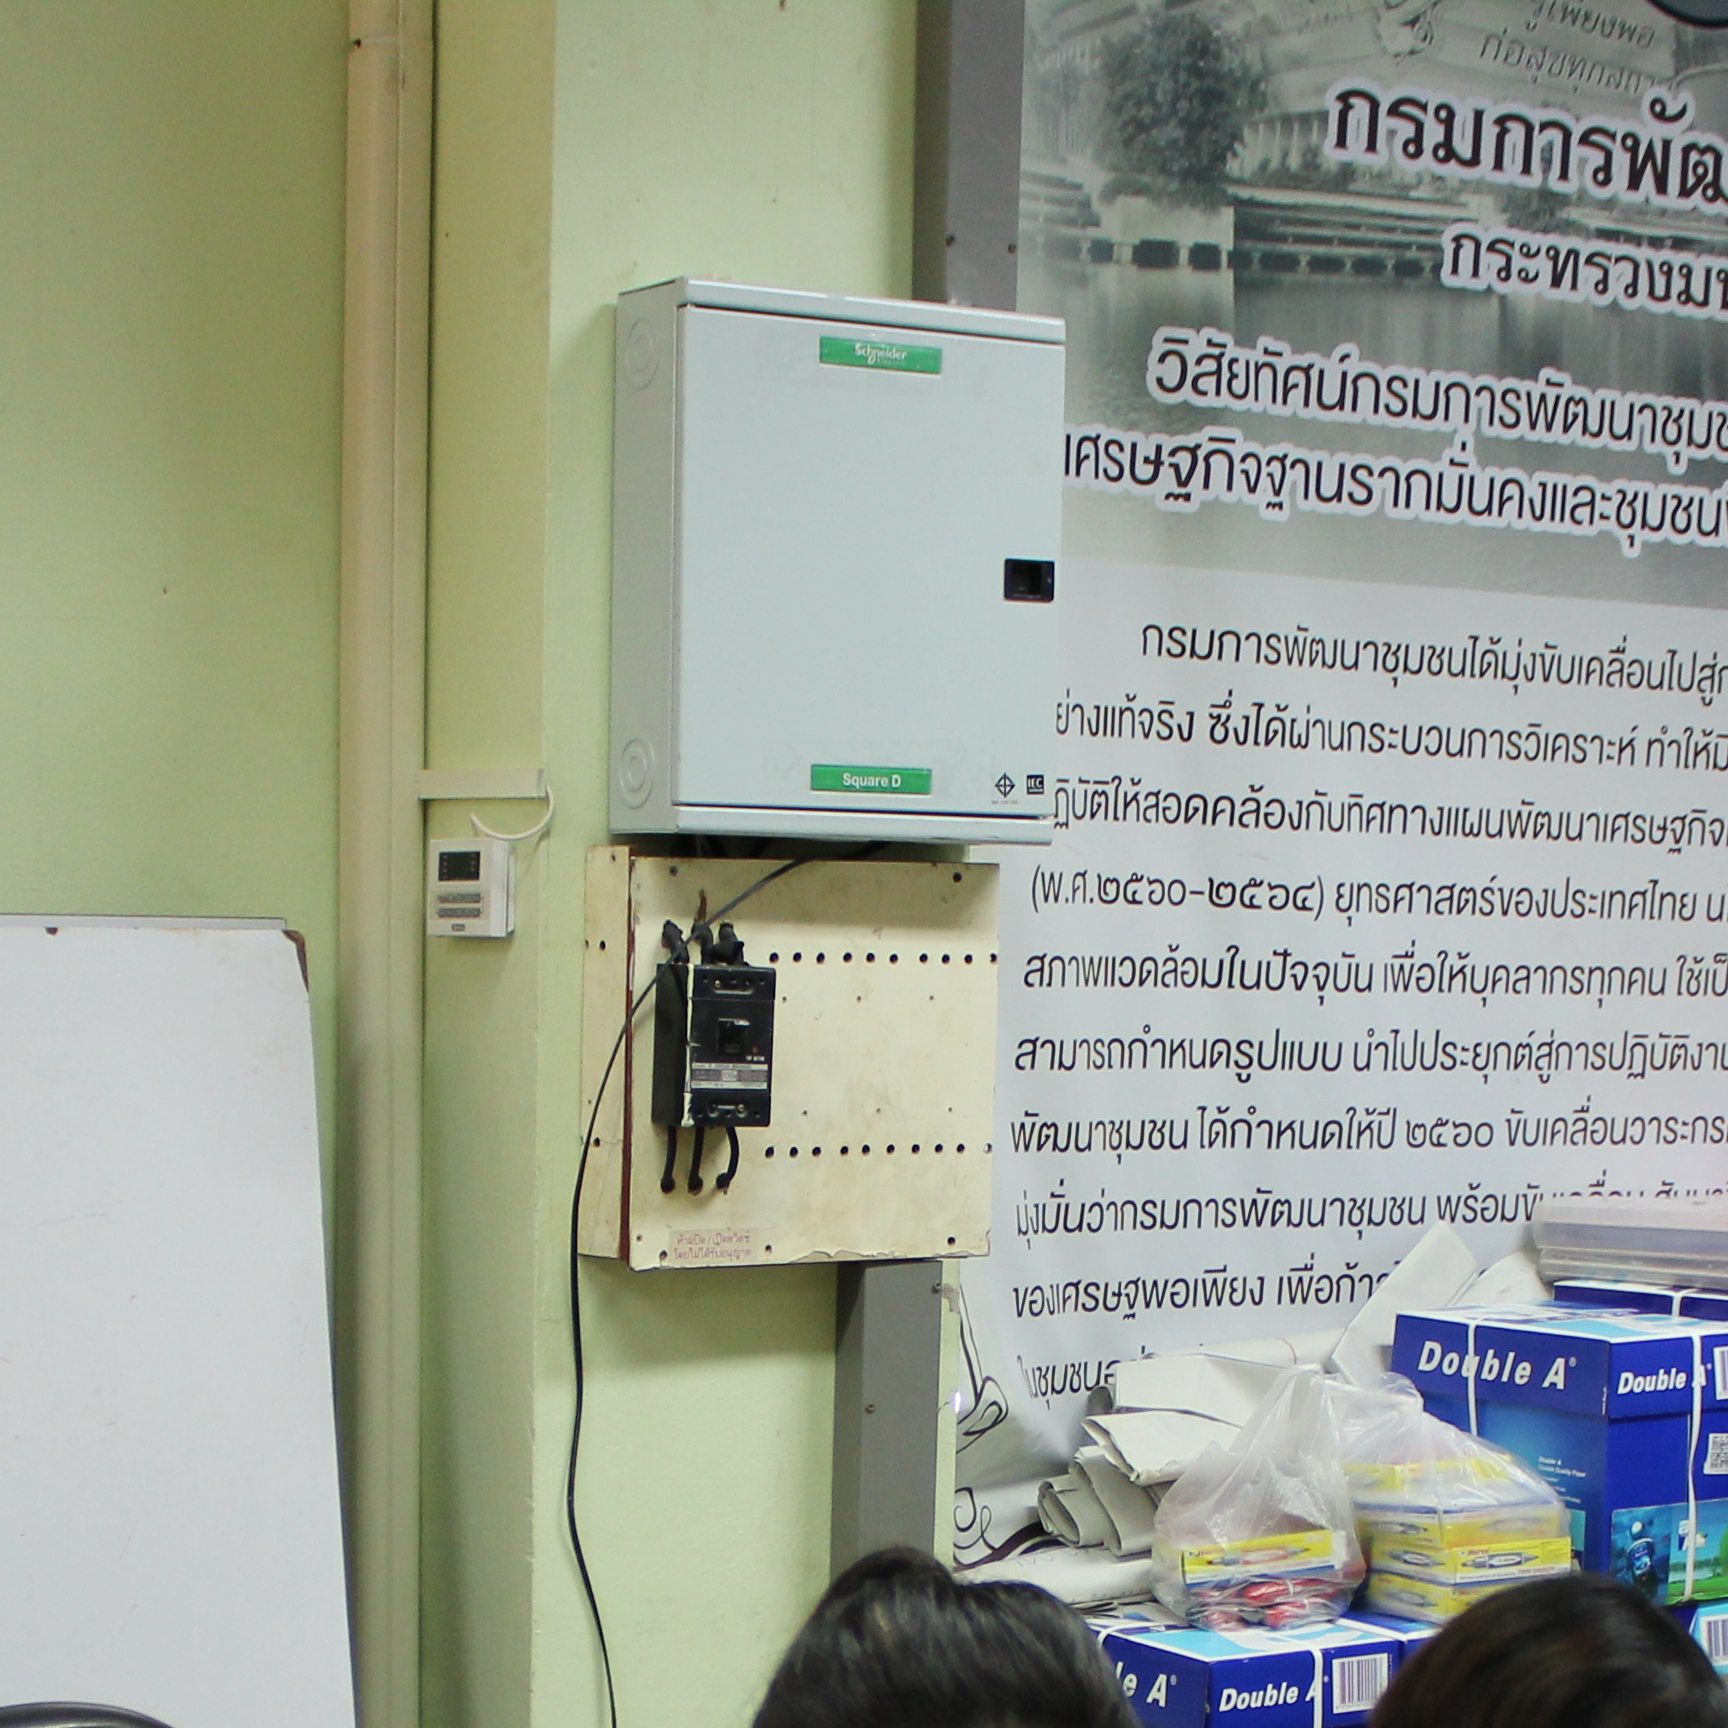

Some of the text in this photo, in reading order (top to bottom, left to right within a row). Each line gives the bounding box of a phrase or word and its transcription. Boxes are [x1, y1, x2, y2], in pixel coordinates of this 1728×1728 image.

[1208, 689, 1636, 767] ซึ่งได้ผ่านกระบวนการวิเคราะห์
[842, 773, 902, 789] Square D
[1030, 863, 1324, 921] (พ.ศ.๒๕๖๐-๒๕๖๔)
[1334, 875, 1696, 928] ยุทธศาสตร์ของประเทศไทย
[1023, 943, 1374, 1006] สภาพแวดล้อมในปัจจุบัน
[1383, 940, 1668, 1008] เพื่อให้บุคลากรทุกคน
[1014, 1024, 1342, 1084] สามารถกำหนดรูปแบบ
[1010, 1110, 1189, 1166] พัฒนาชุมชน
[1198, 1105, 1396, 1151] ได้กำหนดให้ปี
[1405, 1122, 1494, 1149] ๒๕๖๐
[1016, 1180, 1426, 1251] มุ่งมั่นว่ากรมการพัฒนาชุมชน
[1012, 1265, 1266, 1321] ของเศรษฐพอเพียง
[1418, 1340, 1570, 1390] Double A
[1616, 1367, 1688, 1396] Double
[1146, 1673, 1169, 1708] A
[1218, 1681, 1299, 1713] Double
